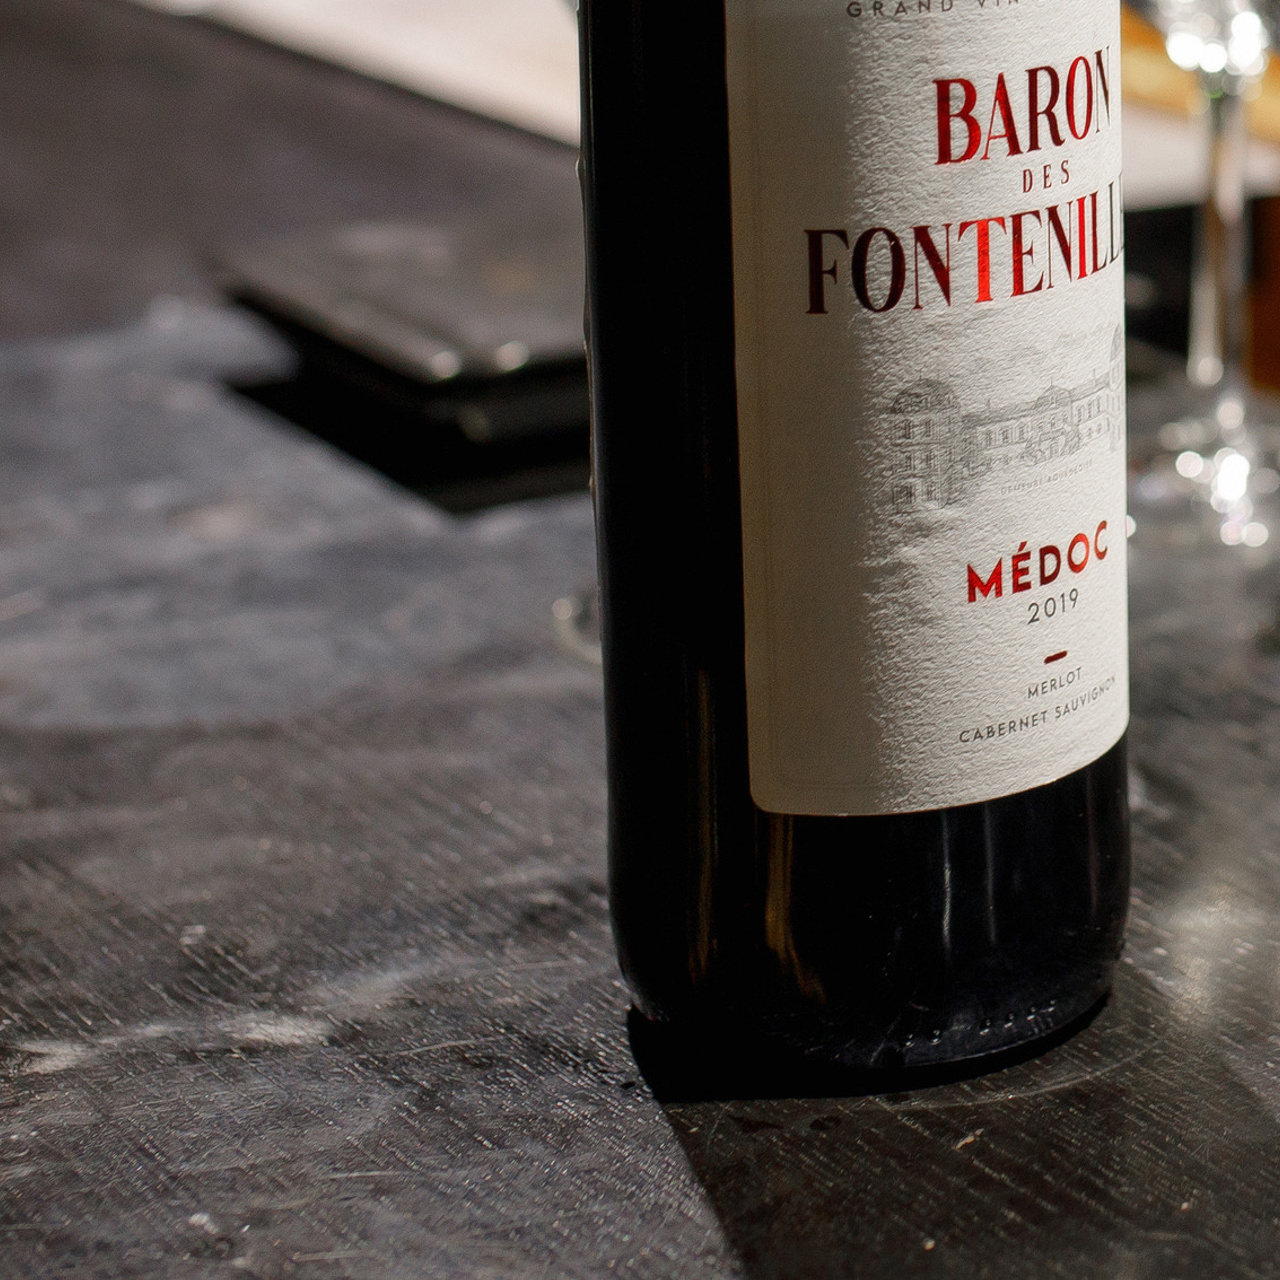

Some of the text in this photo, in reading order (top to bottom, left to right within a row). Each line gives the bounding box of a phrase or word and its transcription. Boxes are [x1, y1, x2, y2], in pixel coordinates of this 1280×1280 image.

[932, 45, 1112, 166] BARON
[1022, 159, 1070, 194] DES
[803, 170, 1123, 315] FONTENILL
[967, 520, 1108, 604] MÉDOC
[1027, 588, 1079, 625] 2019
[1027, 667, 1082, 699] MERLOT
[959, 710, 1048, 743] CABERNET
